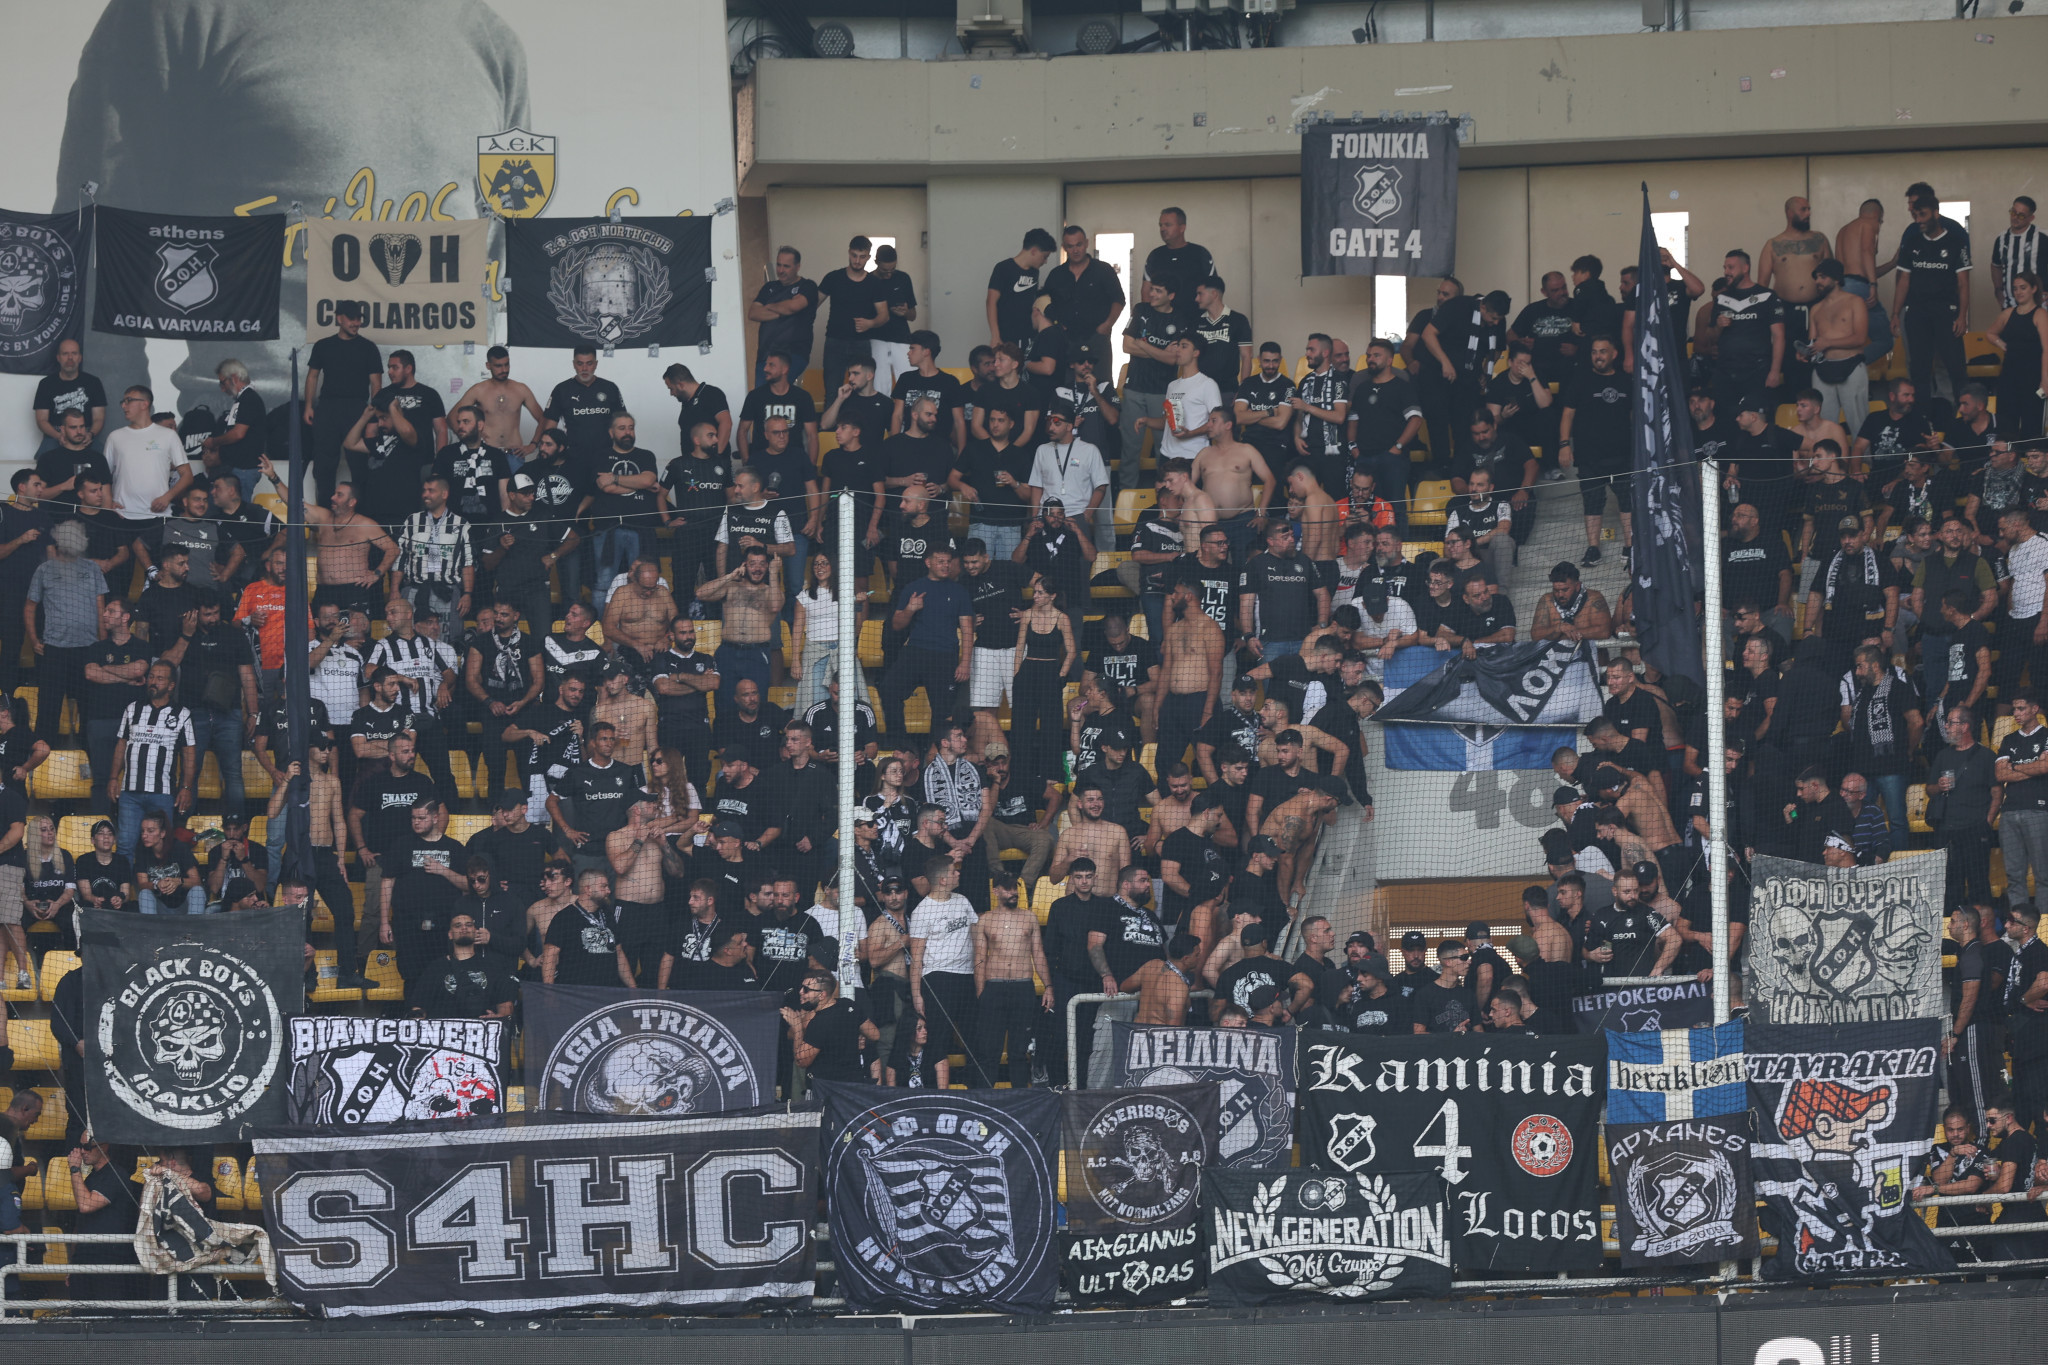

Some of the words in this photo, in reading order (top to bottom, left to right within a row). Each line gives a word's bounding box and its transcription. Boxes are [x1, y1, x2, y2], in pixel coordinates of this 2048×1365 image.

[1330, 133, 1429, 159] FOINIKIA
[16, 226, 66, 260] BOYS
[149, 225, 225, 240] athens
[601, 225, 642, 240] NORTH
[642, 231, 673, 252] CLUB
[1330, 228, 1400, 258] GATE
[1404, 229, 1422, 258] 4
[2, 255, 14, 269] 4
[1912, 259, 1948, 271] betsson
[14, 339, 30, 351] BY
[34, 317, 61, 345] YOUR
[58, 285, 71, 315] SIDE
[113, 313, 154, 330] AGIA
[158, 317, 236, 333] VARVARA
[239, 319, 261, 333] G4
[1732, 310, 1757, 320] tsson
[573, 405, 610, 417] betsson
[1267, 573, 1306, 583] betsson
[118, 957, 192, 1009] BLACK
[199, 958, 257, 1006] BOYS
[1572, 982, 1707, 1013] ΠΕΤΡΟΚΕΦΑΛΙ
[173, 1004, 188, 1020] 4
[293, 1019, 500, 1062] BIANCONERI
[551, 1015, 622, 1089] AGIA
[632, 1008, 749, 1092] TRIADA
[447, 1060, 477, 1079] 184
[1307, 1044, 1596, 1097] Kaminia
[1744, 1047, 1937, 1083] TAVRAKIA
[129, 1073, 250, 1111] IRAKLIO
[1413, 1098, 1473, 1185] 4
[1098, 1188, 1119, 1208] NOT
[1117, 1203, 1165, 1219] NORMAL
[1163, 1187, 1190, 1212] FANS
[1458, 1191, 1597, 1242] Locos
[273, 1147, 805, 1291] S4HC
[1213, 1206, 1277, 1261] NEW
[1282, 1202, 1444, 1258] GENERATION
[1112, 1222, 1197, 1258] GIANNIS
[1327, 1251, 1387, 1281] Gruppo
